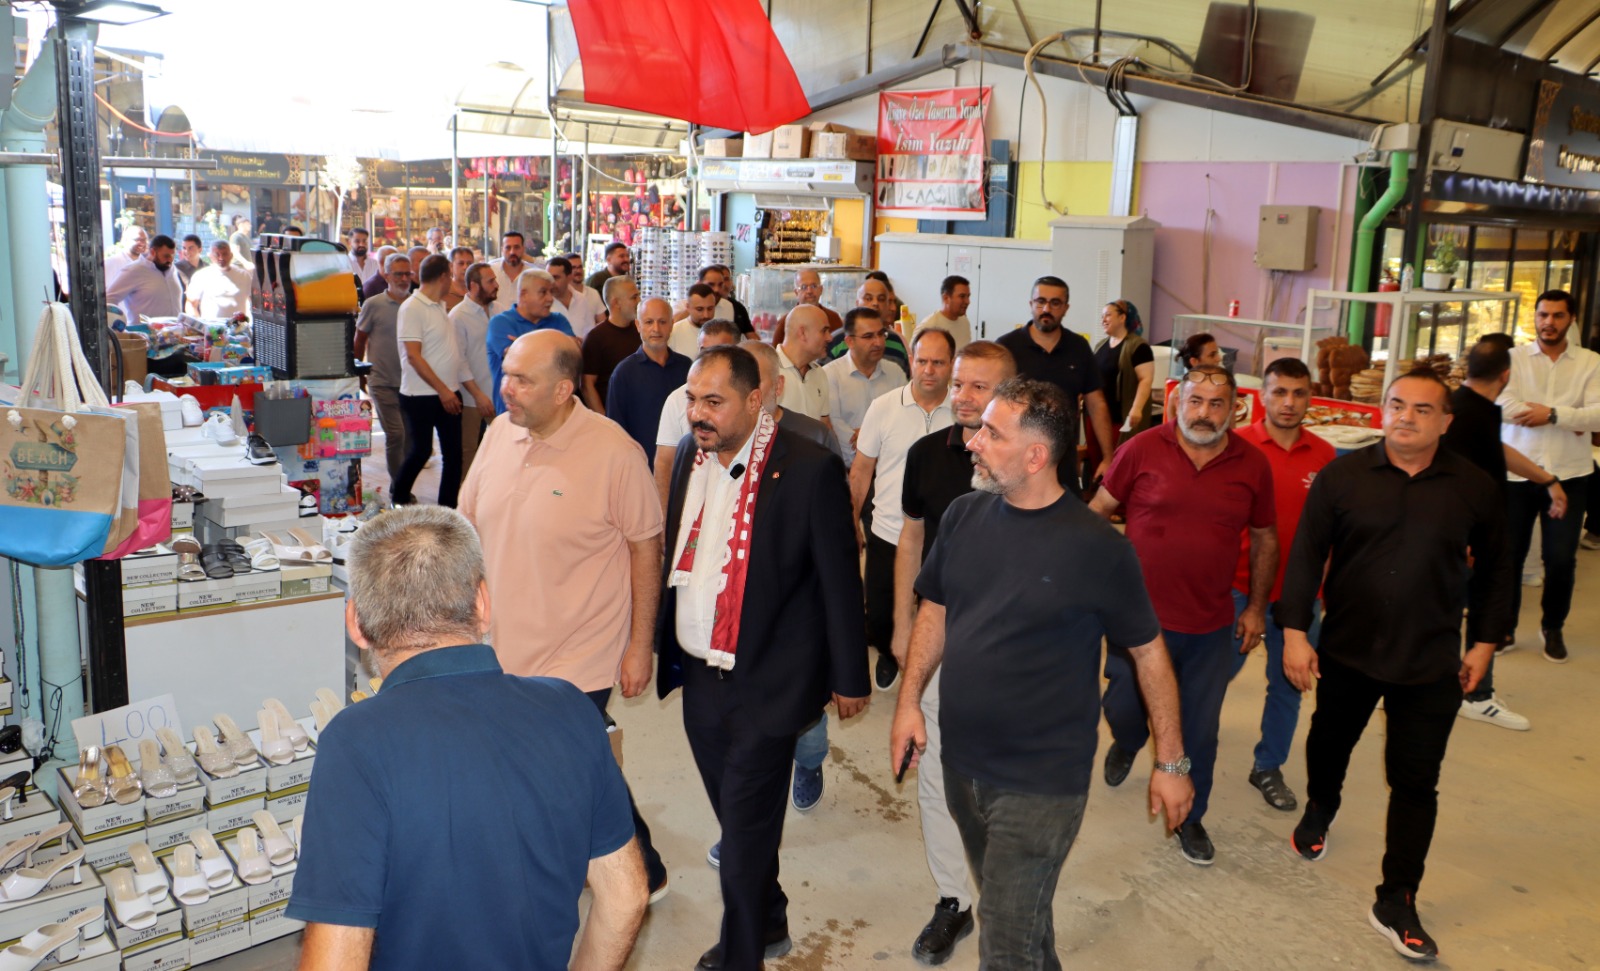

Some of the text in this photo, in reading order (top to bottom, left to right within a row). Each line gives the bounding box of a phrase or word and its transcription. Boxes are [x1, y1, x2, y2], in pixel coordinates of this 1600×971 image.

[894, 127, 975, 152] İsim Yazılır
[16, 446, 69, 466] BEACH
[189, 597, 223, 606] COLLECTION
[131, 604, 166, 614] COLLECTION
[280, 776, 311, 788] COLLECTIO
[289, 773, 303, 782] NEW
[221, 788, 256, 801] COLLECTION
[231, 786, 246, 794] NEW
[155, 803, 192, 816] COLLECTION
[94, 817, 134, 831] COLLECTION
[105, 815, 122, 824] NEW
[228, 816, 244, 825] NEW
[169, 831, 184, 841] NEW
[105, 851, 129, 862] COLLEC
[259, 891, 292, 905] COLLECTIO
[269, 888, 285, 898] NEW
[193, 906, 244, 926] NEW COLLECTION
[128, 927, 169, 944] COLLECTION
